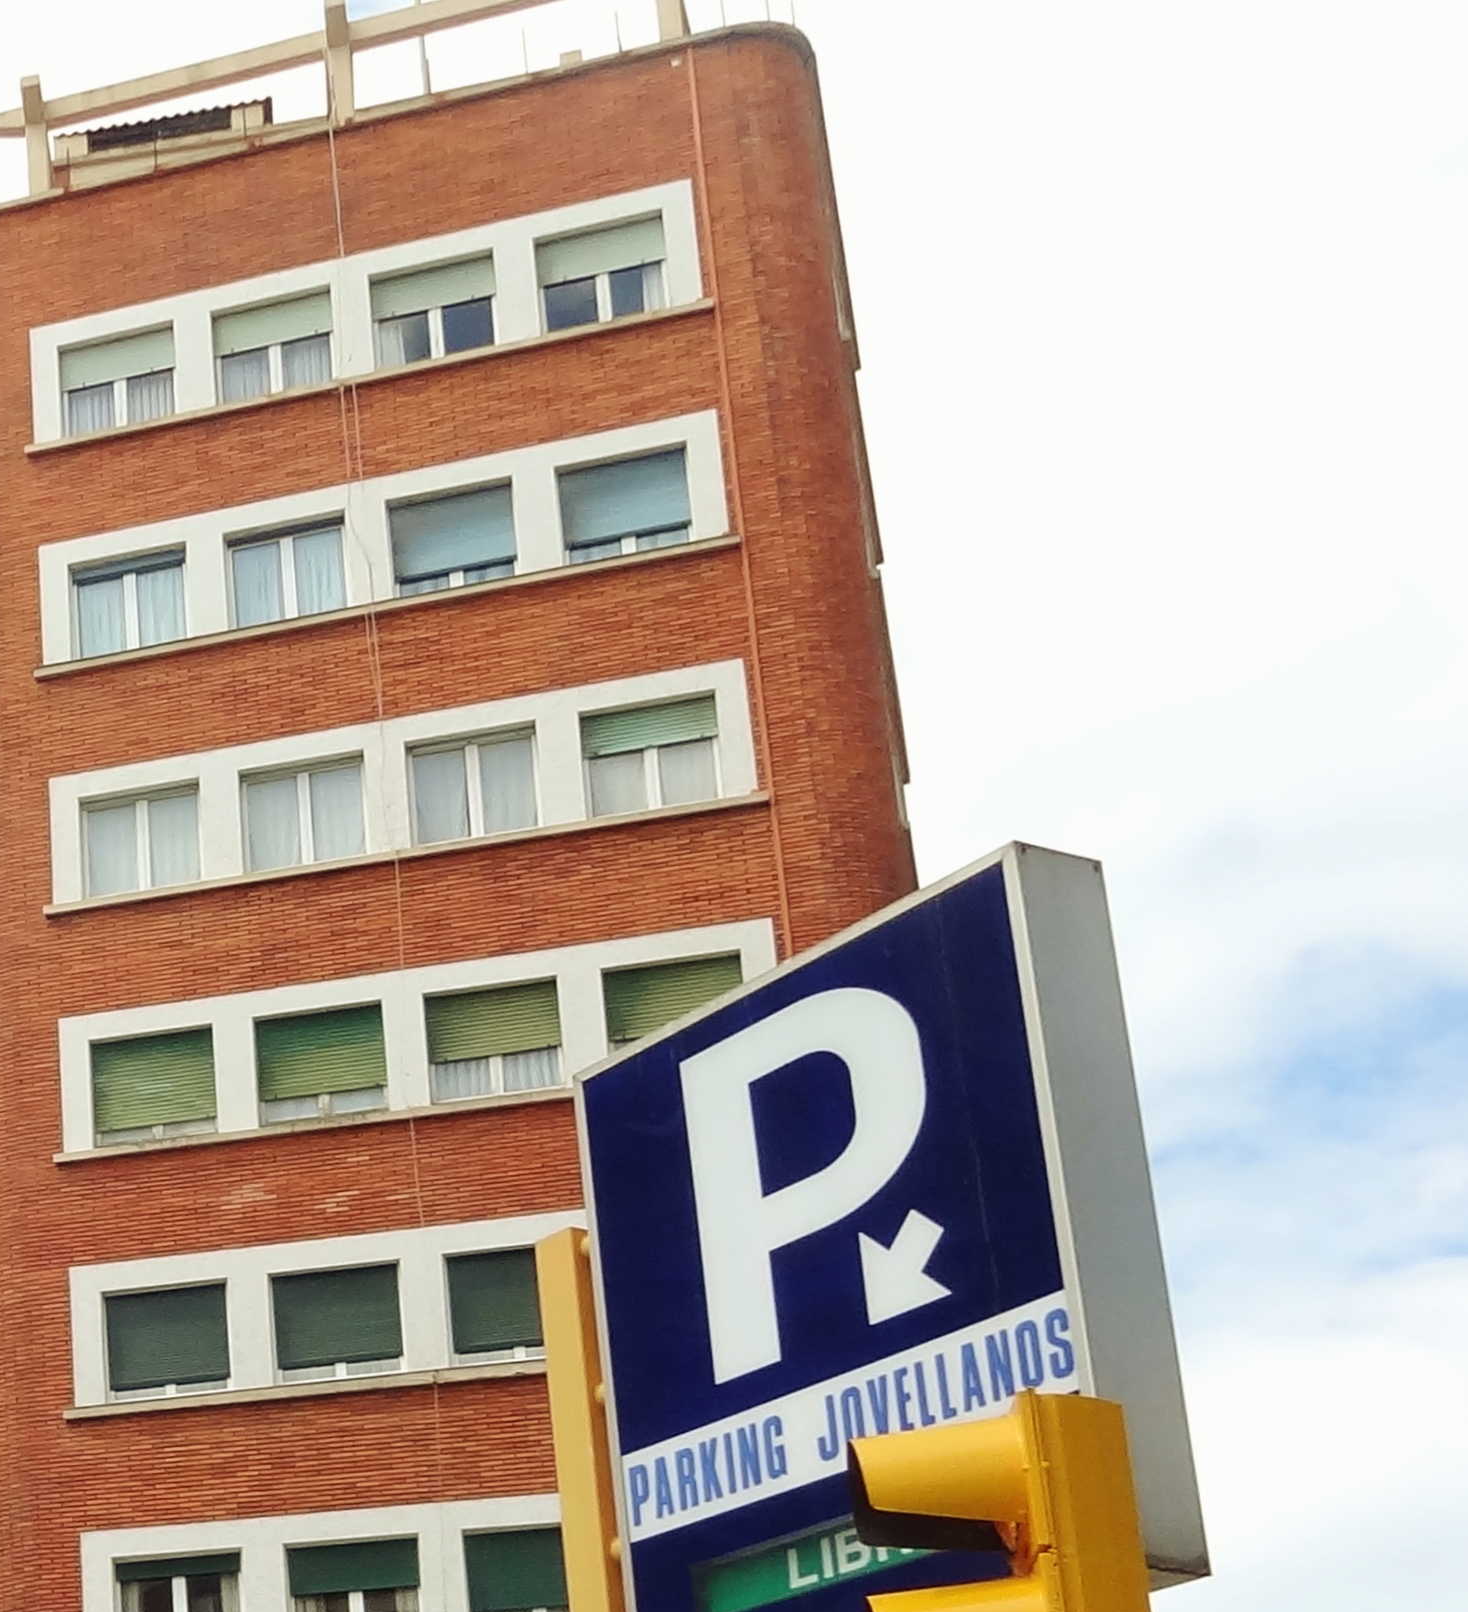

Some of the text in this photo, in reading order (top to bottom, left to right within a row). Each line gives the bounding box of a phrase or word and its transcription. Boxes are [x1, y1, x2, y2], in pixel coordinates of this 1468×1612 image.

[679, 986, 927, 1386] P
[628, 1307, 1075, 1527] PARKING JOVELLANOS
